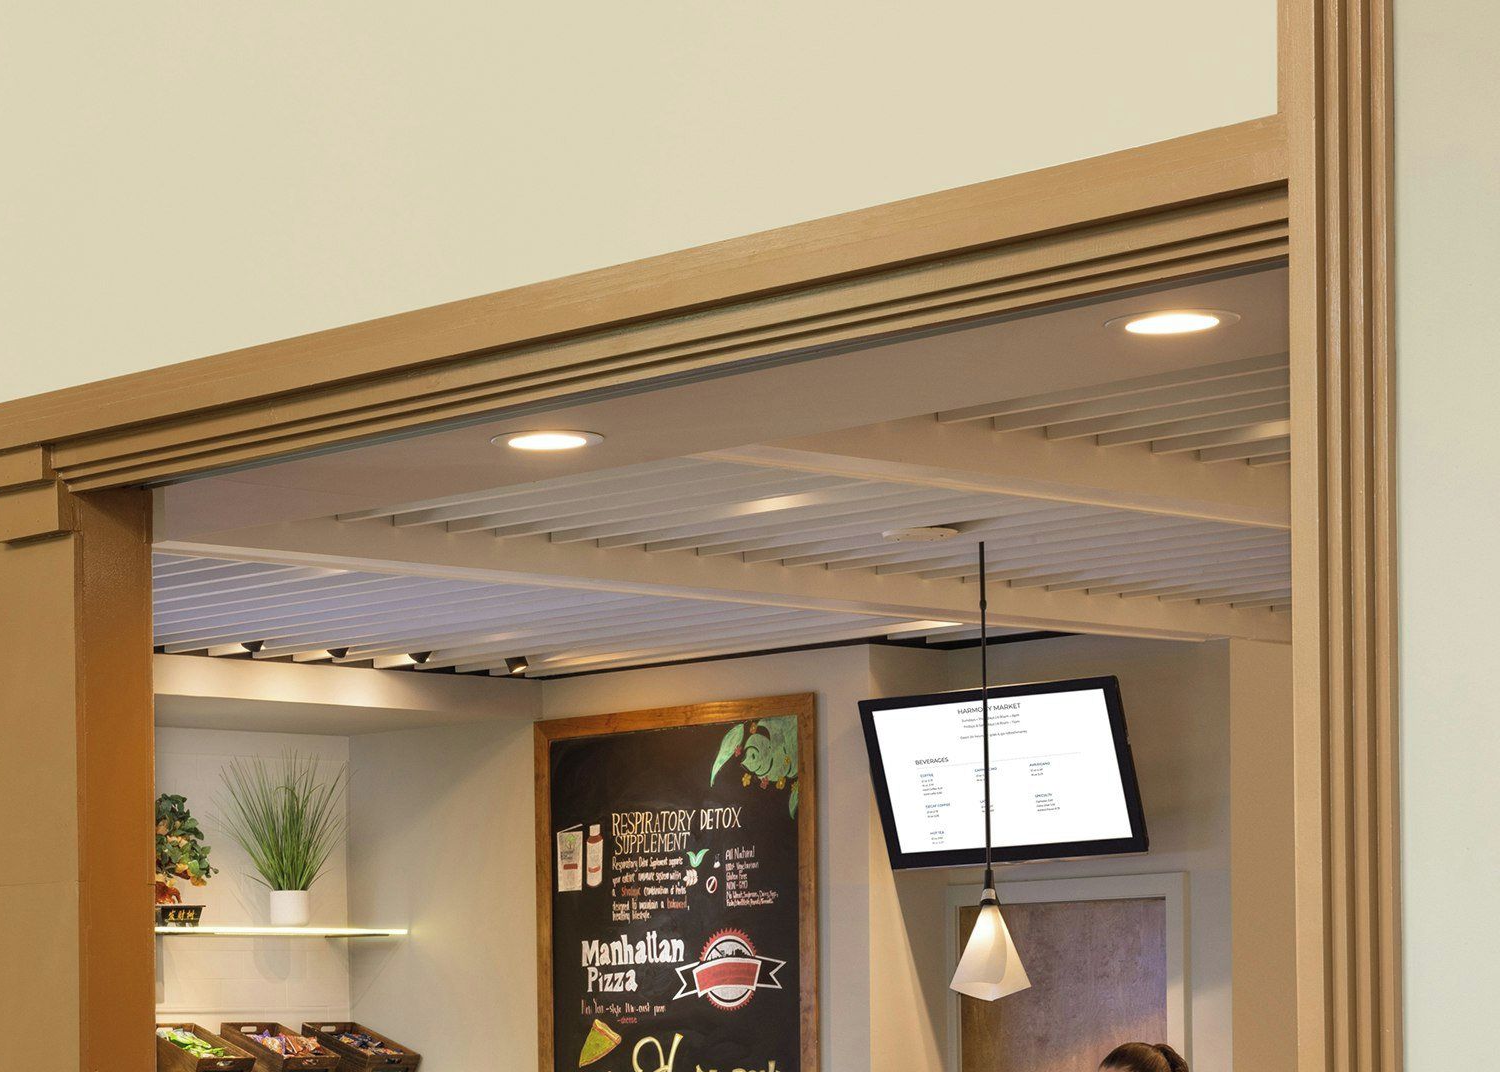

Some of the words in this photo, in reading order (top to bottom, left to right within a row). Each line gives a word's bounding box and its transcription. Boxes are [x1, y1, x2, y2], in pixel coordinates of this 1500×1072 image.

[957, 705, 992, 716] HARMOY
[993, 702, 1021, 713] MARKET
[915, 757, 949, 766] BEVERAGES
[611, 810, 695, 837] RESPIRATORY
[699, 806, 743, 830] DETOX
[613, 832, 691, 856] SUPPLEMENT
[581, 931, 685, 968] Manhattan
[587, 968, 638, 993] Pizza
